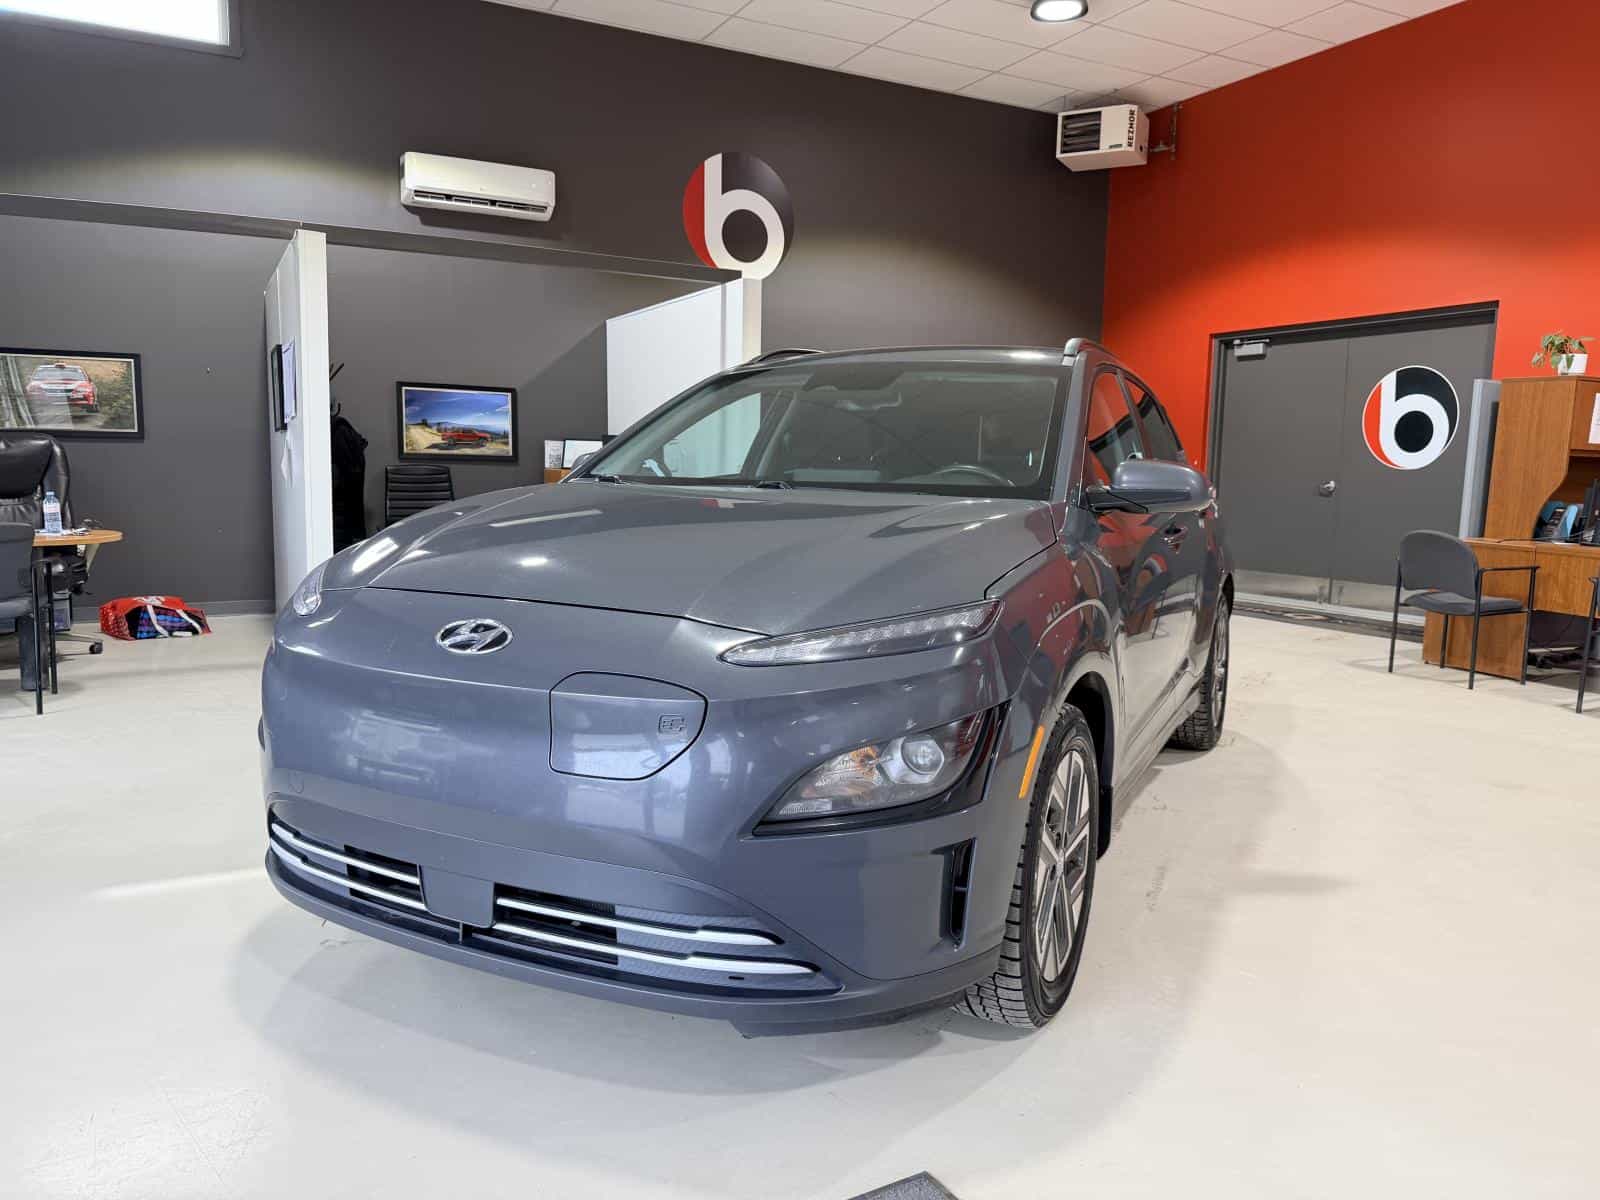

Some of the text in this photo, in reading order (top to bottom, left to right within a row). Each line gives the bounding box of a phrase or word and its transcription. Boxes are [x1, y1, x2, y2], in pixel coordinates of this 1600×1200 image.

[1127, 109, 1136, 147] REZNOR
[702, 152, 786, 281] b
[1375, 368, 1452, 470] b
